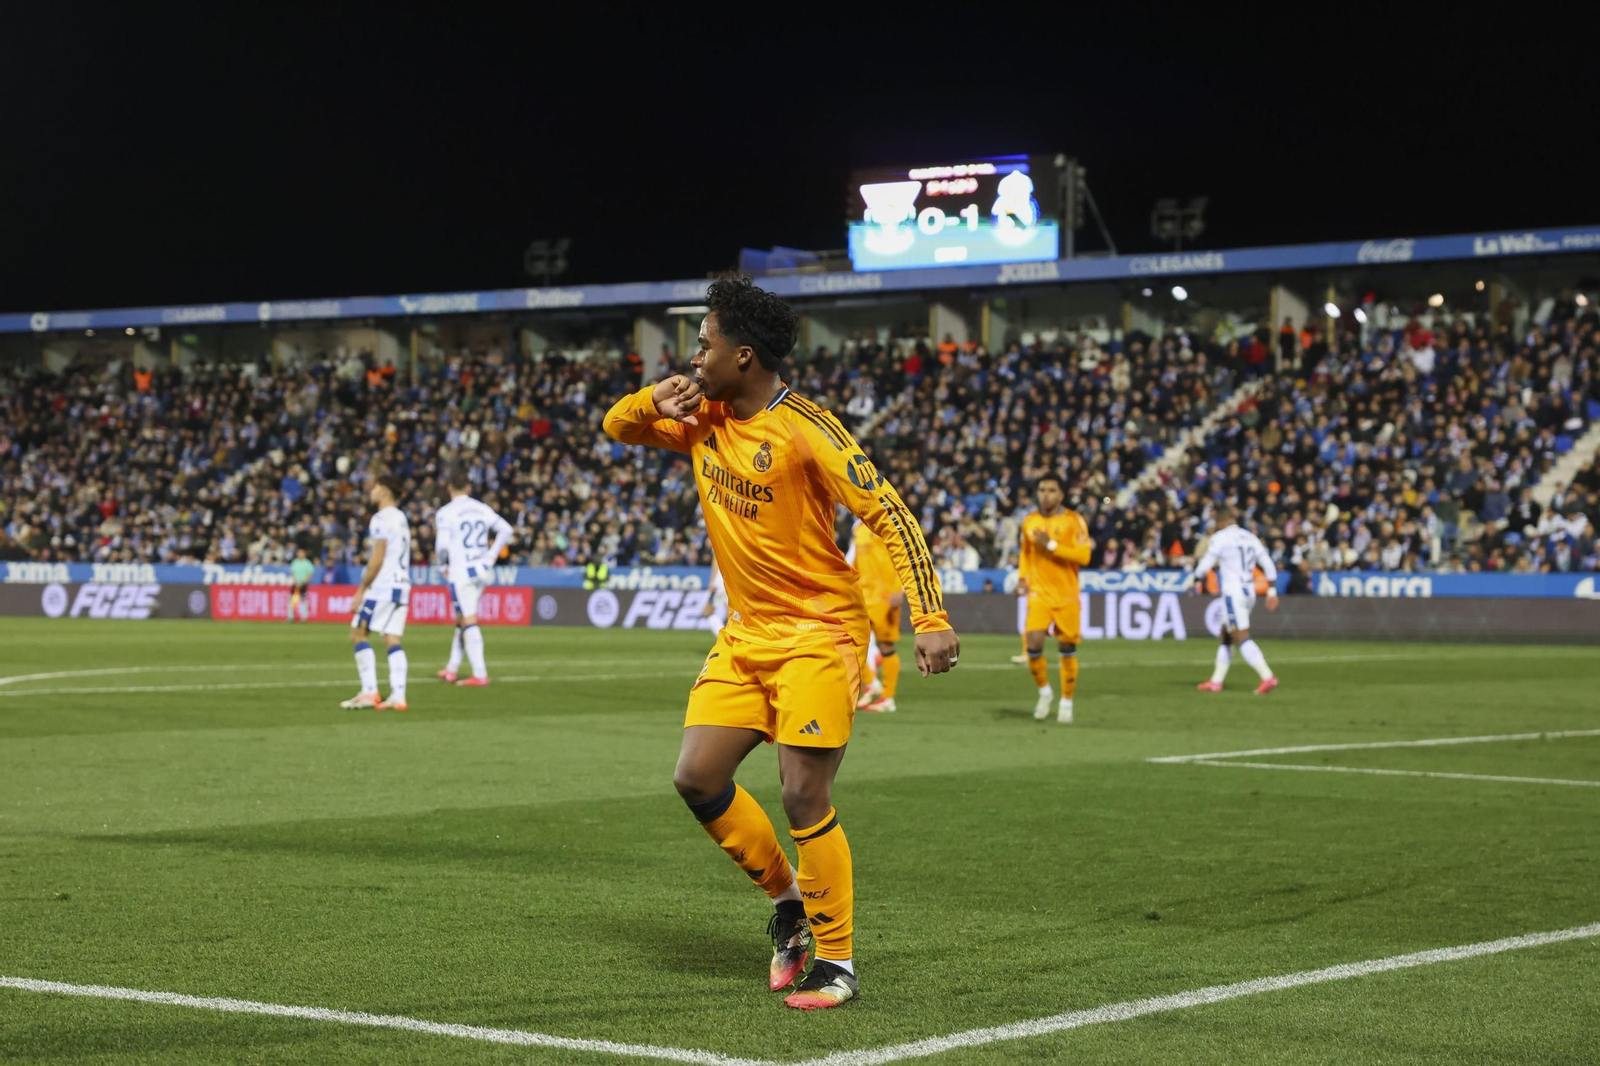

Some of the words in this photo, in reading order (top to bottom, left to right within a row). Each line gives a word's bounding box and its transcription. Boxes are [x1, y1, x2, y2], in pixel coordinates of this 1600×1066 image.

[702, 455, 773, 503] Emirates
[848, 454, 882, 490] hp
[706, 484, 722, 505] FLY
[724, 492, 758, 520] BETTER
[460, 520, 487, 549] 22
[1079, 570, 1196, 593] RCANZ
[622, 590, 711, 630] FC2
[1018, 592, 1187, 642] LIGA
